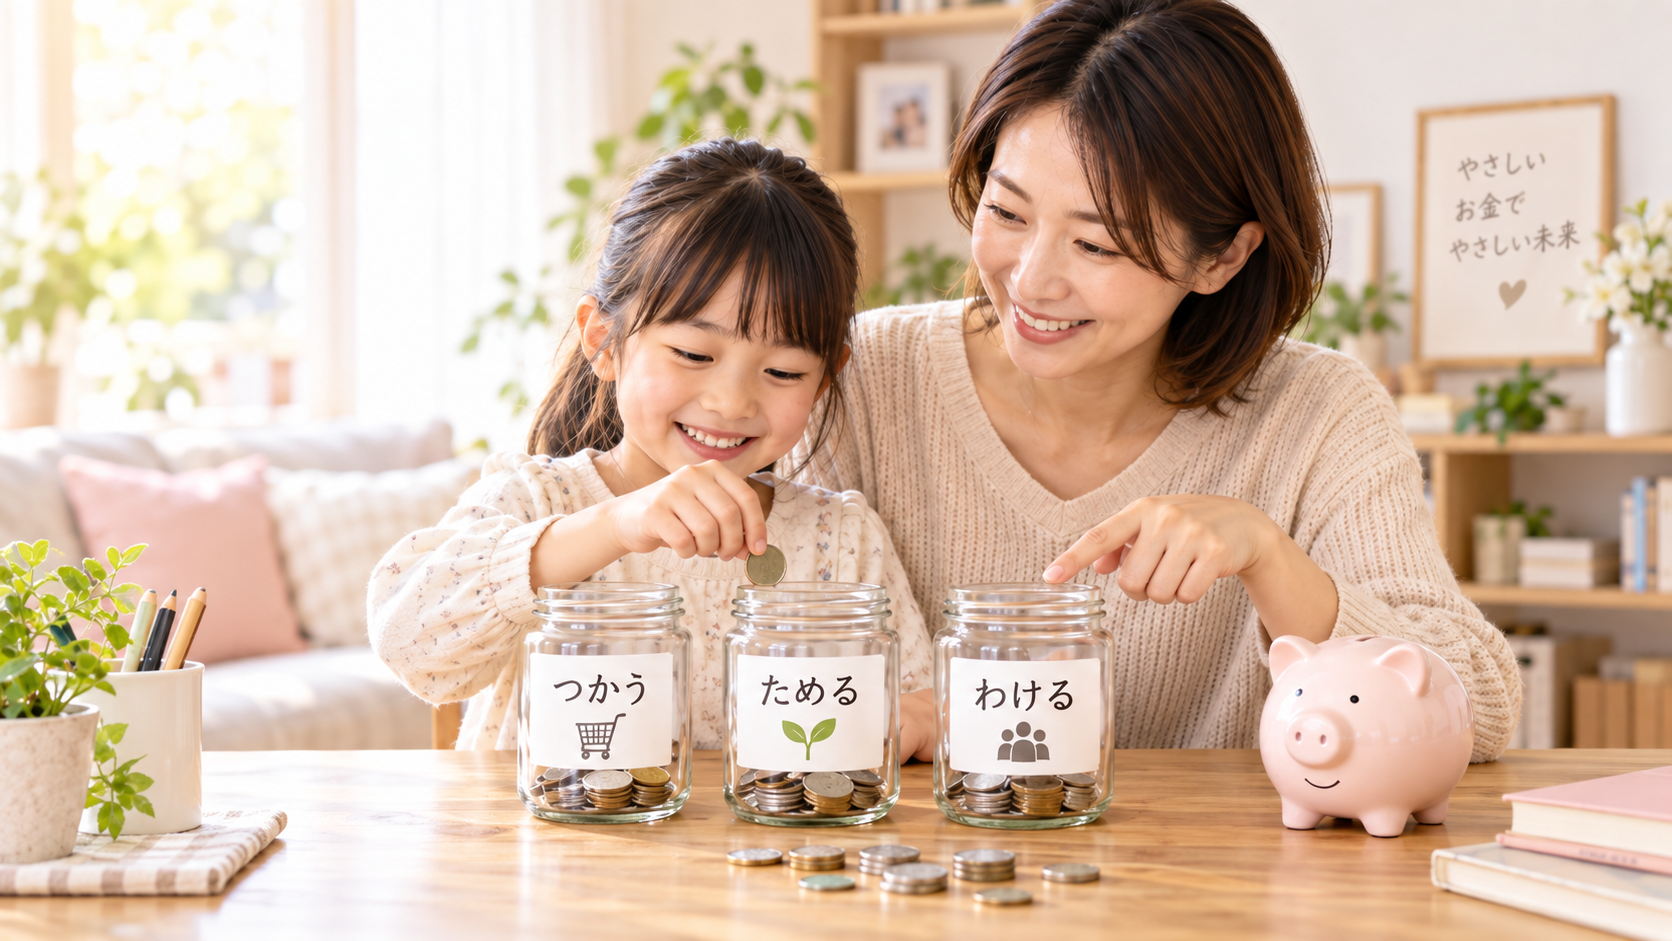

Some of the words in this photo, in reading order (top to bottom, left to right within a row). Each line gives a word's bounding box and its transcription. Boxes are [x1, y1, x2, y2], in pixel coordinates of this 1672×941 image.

[1458, 152, 1545, 181] やさしい
[1455, 191, 1525, 222] お金で
[1450, 220, 1580, 262] やさしい未来
[553, 672, 646, 706] つかう
[761, 674, 858, 707] ためる
[975, 678, 1073, 712] わける
